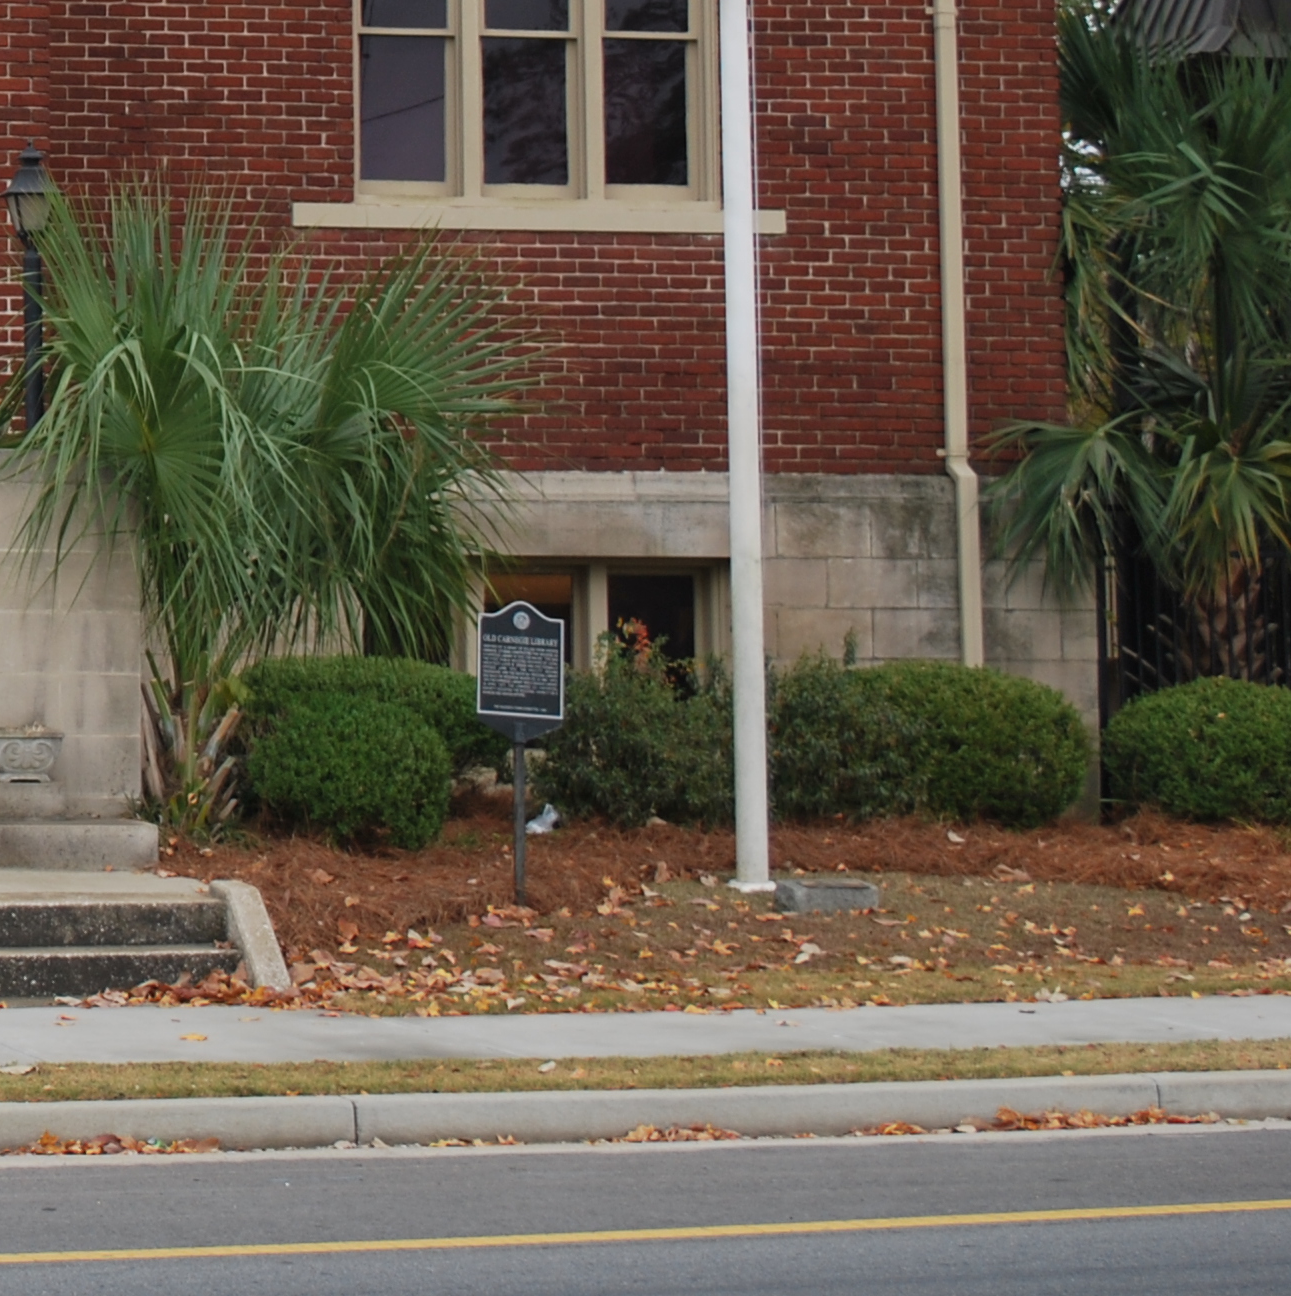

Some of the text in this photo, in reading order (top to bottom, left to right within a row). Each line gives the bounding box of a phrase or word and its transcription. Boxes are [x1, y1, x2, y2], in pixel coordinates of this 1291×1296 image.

[483, 634, 558, 647] OLD CARNEGIE LIBRARY
